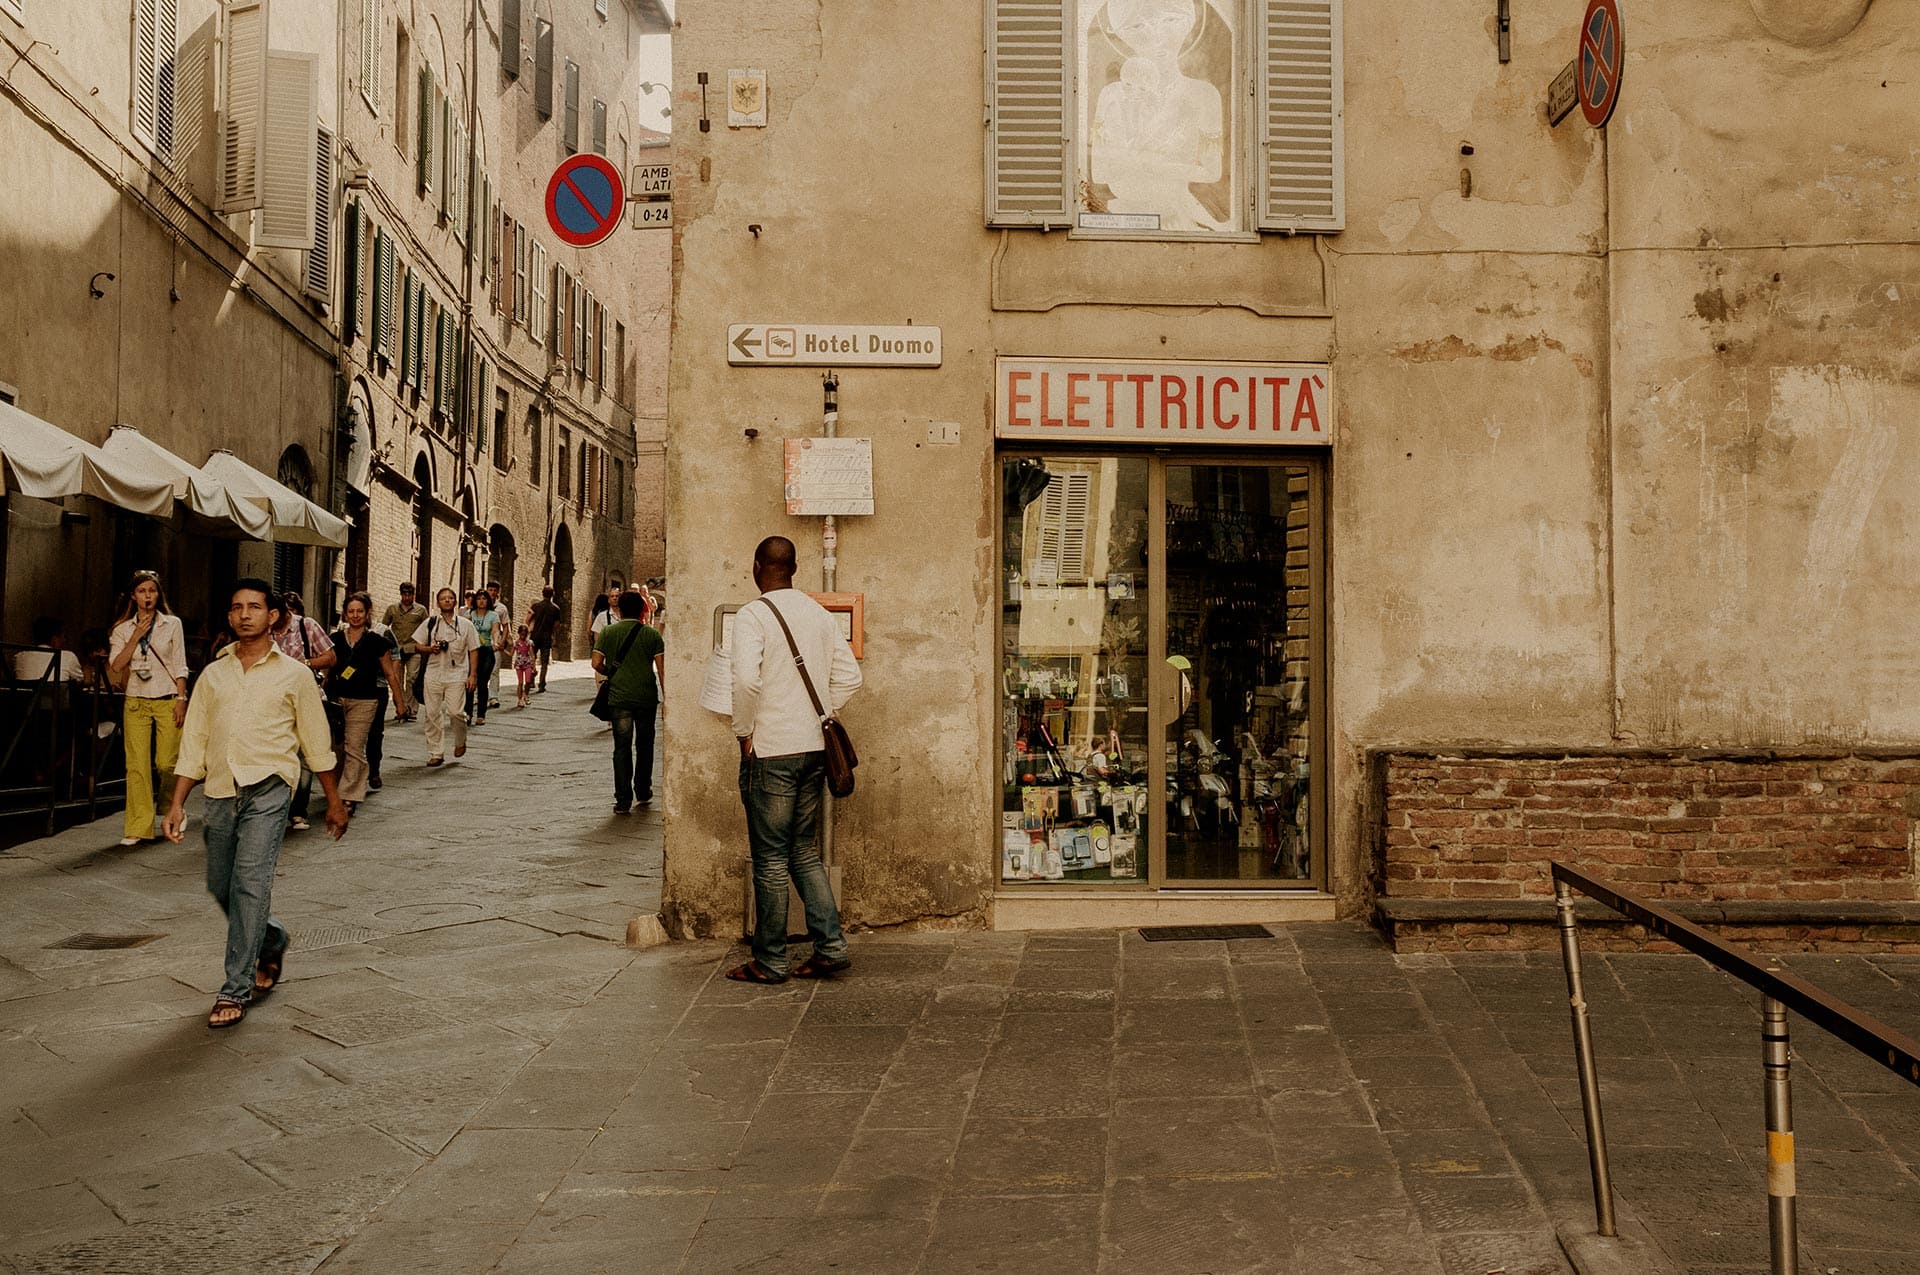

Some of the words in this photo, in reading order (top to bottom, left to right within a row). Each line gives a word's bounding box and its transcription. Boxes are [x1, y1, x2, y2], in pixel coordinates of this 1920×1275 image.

[641, 168, 671, 178] AMB
[643, 209, 668, 221] 0-24
[805, 334, 859, 353] Hotel
[869, 334, 934, 354] Duomo
[1008, 371, 1324, 432] ELETTRICITÀ
